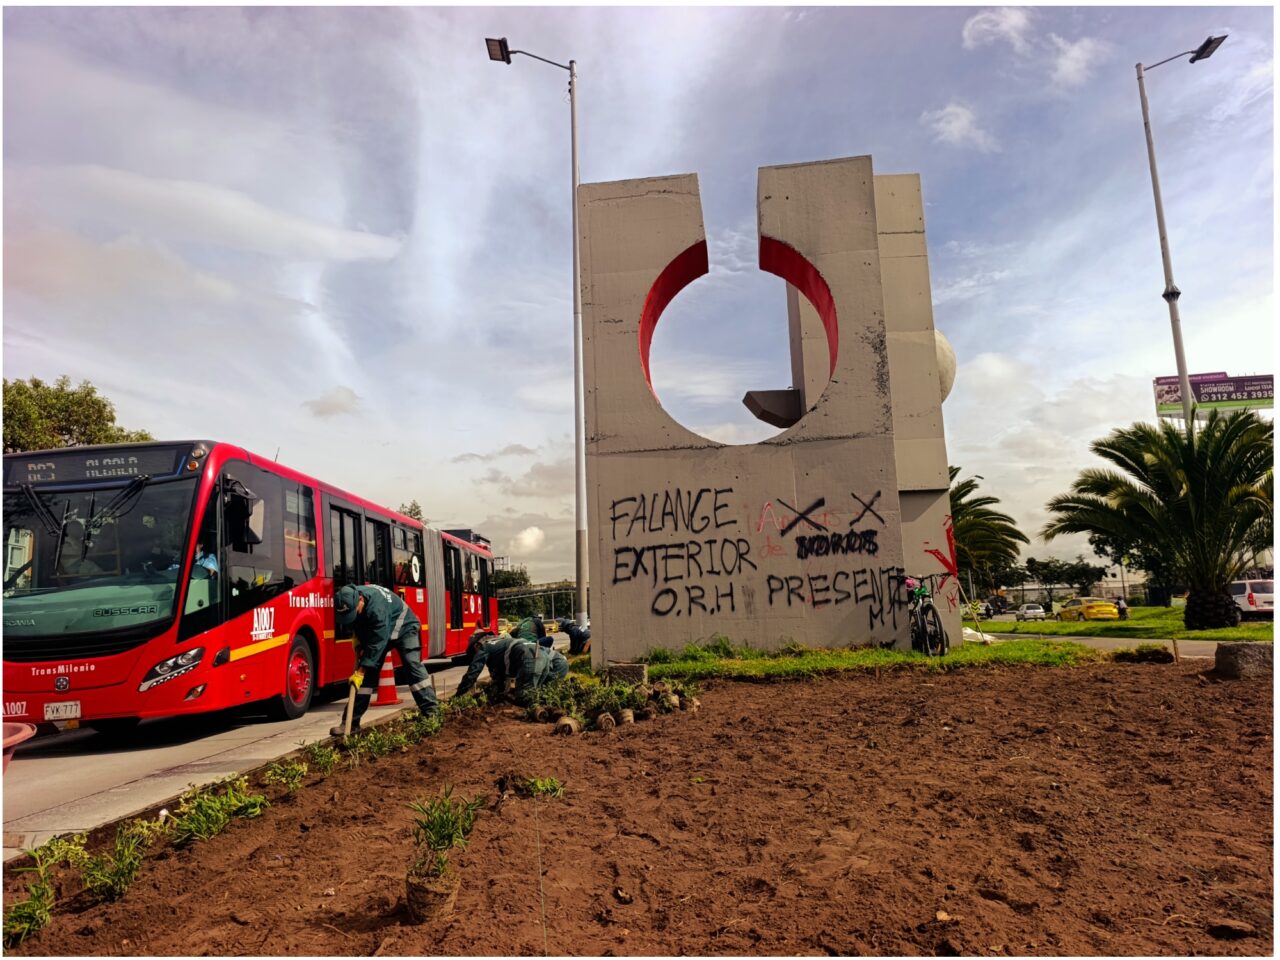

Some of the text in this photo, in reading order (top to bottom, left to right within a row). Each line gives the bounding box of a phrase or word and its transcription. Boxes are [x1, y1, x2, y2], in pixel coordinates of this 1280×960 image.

[1211, 390, 1274, 401] 312 452 3935
[609, 488, 737, 540] FALANGE
[613, 538, 757, 588] EXTERIOR
[288, 591, 334, 608] TransMilenio
[652, 582, 735, 616] O.R.H
[767, 566, 908, 610] PRESENTE
[93, 605, 157, 617] BUSSCAR
[253, 606, 275, 633] A1007
[31, 663, 96, 677] TransMilenio
